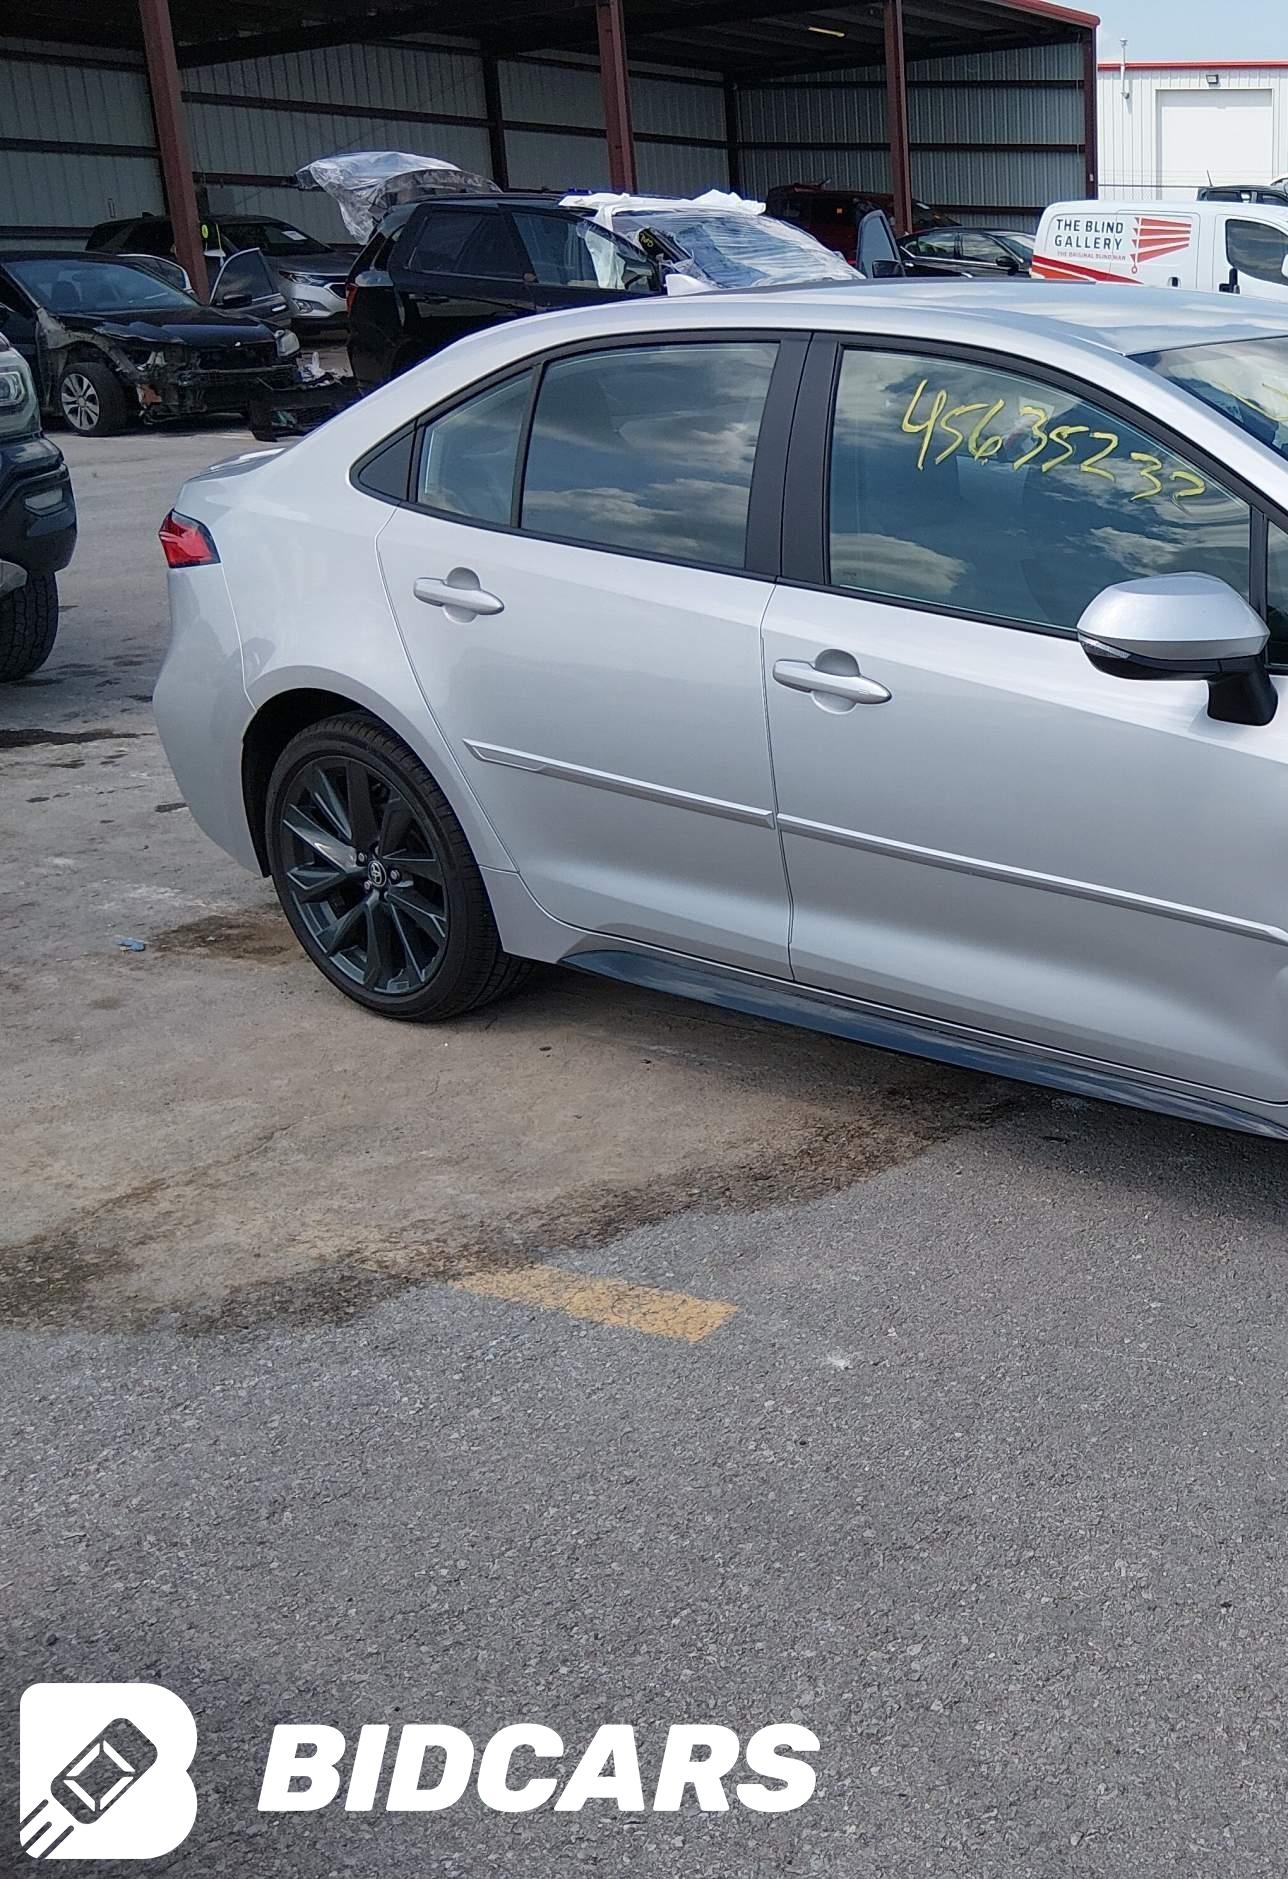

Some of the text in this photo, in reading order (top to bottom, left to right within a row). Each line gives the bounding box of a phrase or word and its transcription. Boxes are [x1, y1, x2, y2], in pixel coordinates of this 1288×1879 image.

[1056, 219, 1124, 234] THE BLIND
[1055, 235, 1122, 250] GALLERY
